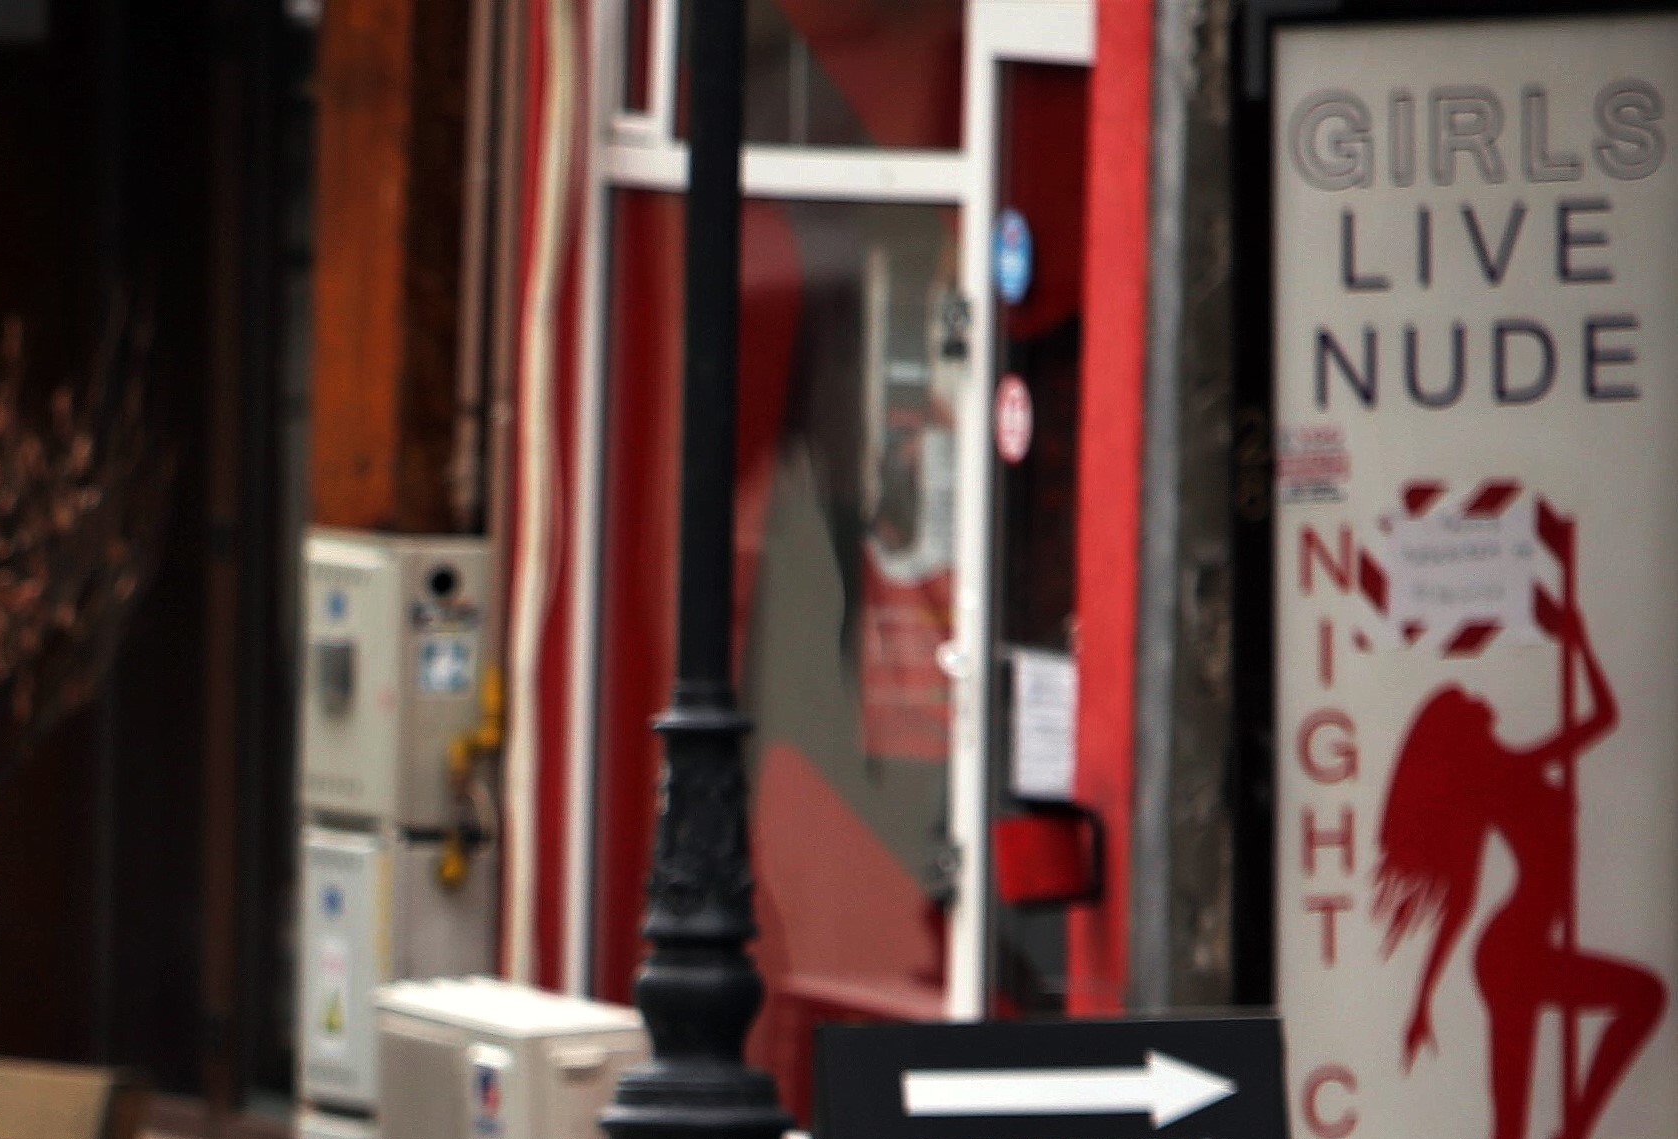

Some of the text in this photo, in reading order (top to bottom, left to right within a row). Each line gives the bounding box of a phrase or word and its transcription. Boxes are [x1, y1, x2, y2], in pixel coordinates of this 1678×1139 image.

[1288, 78, 1665, 191] GIRLS
[1340, 197, 1615, 292] LIVE
[1313, 315, 1641, 409] NUDE
